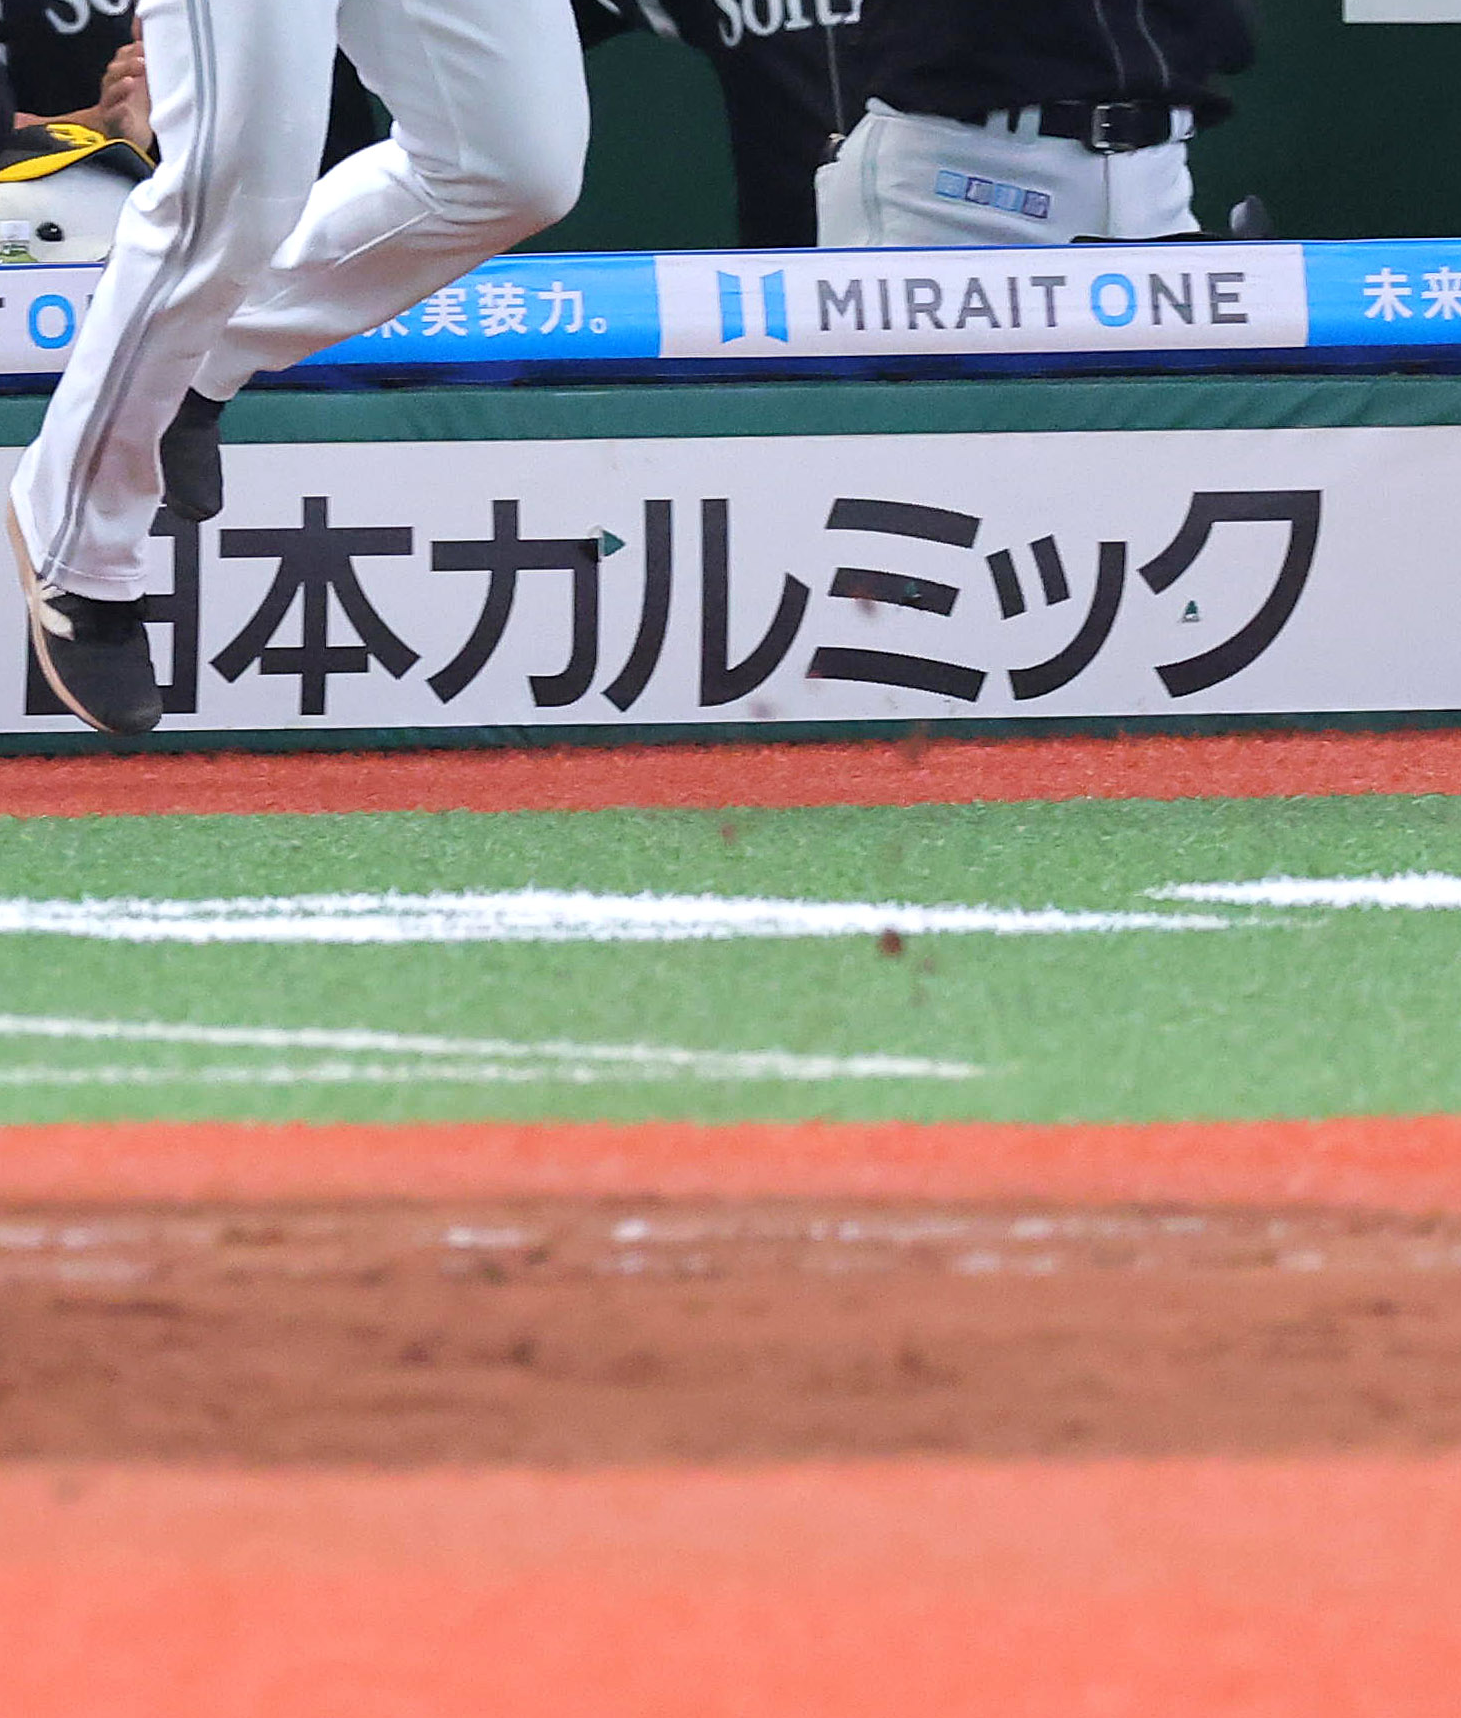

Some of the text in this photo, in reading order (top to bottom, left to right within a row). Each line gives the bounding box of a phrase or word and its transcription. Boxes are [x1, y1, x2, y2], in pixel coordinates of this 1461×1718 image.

[363, 280, 607, 338] 実装力。
[819, 271, 1249, 332] MIRAIT ONE
